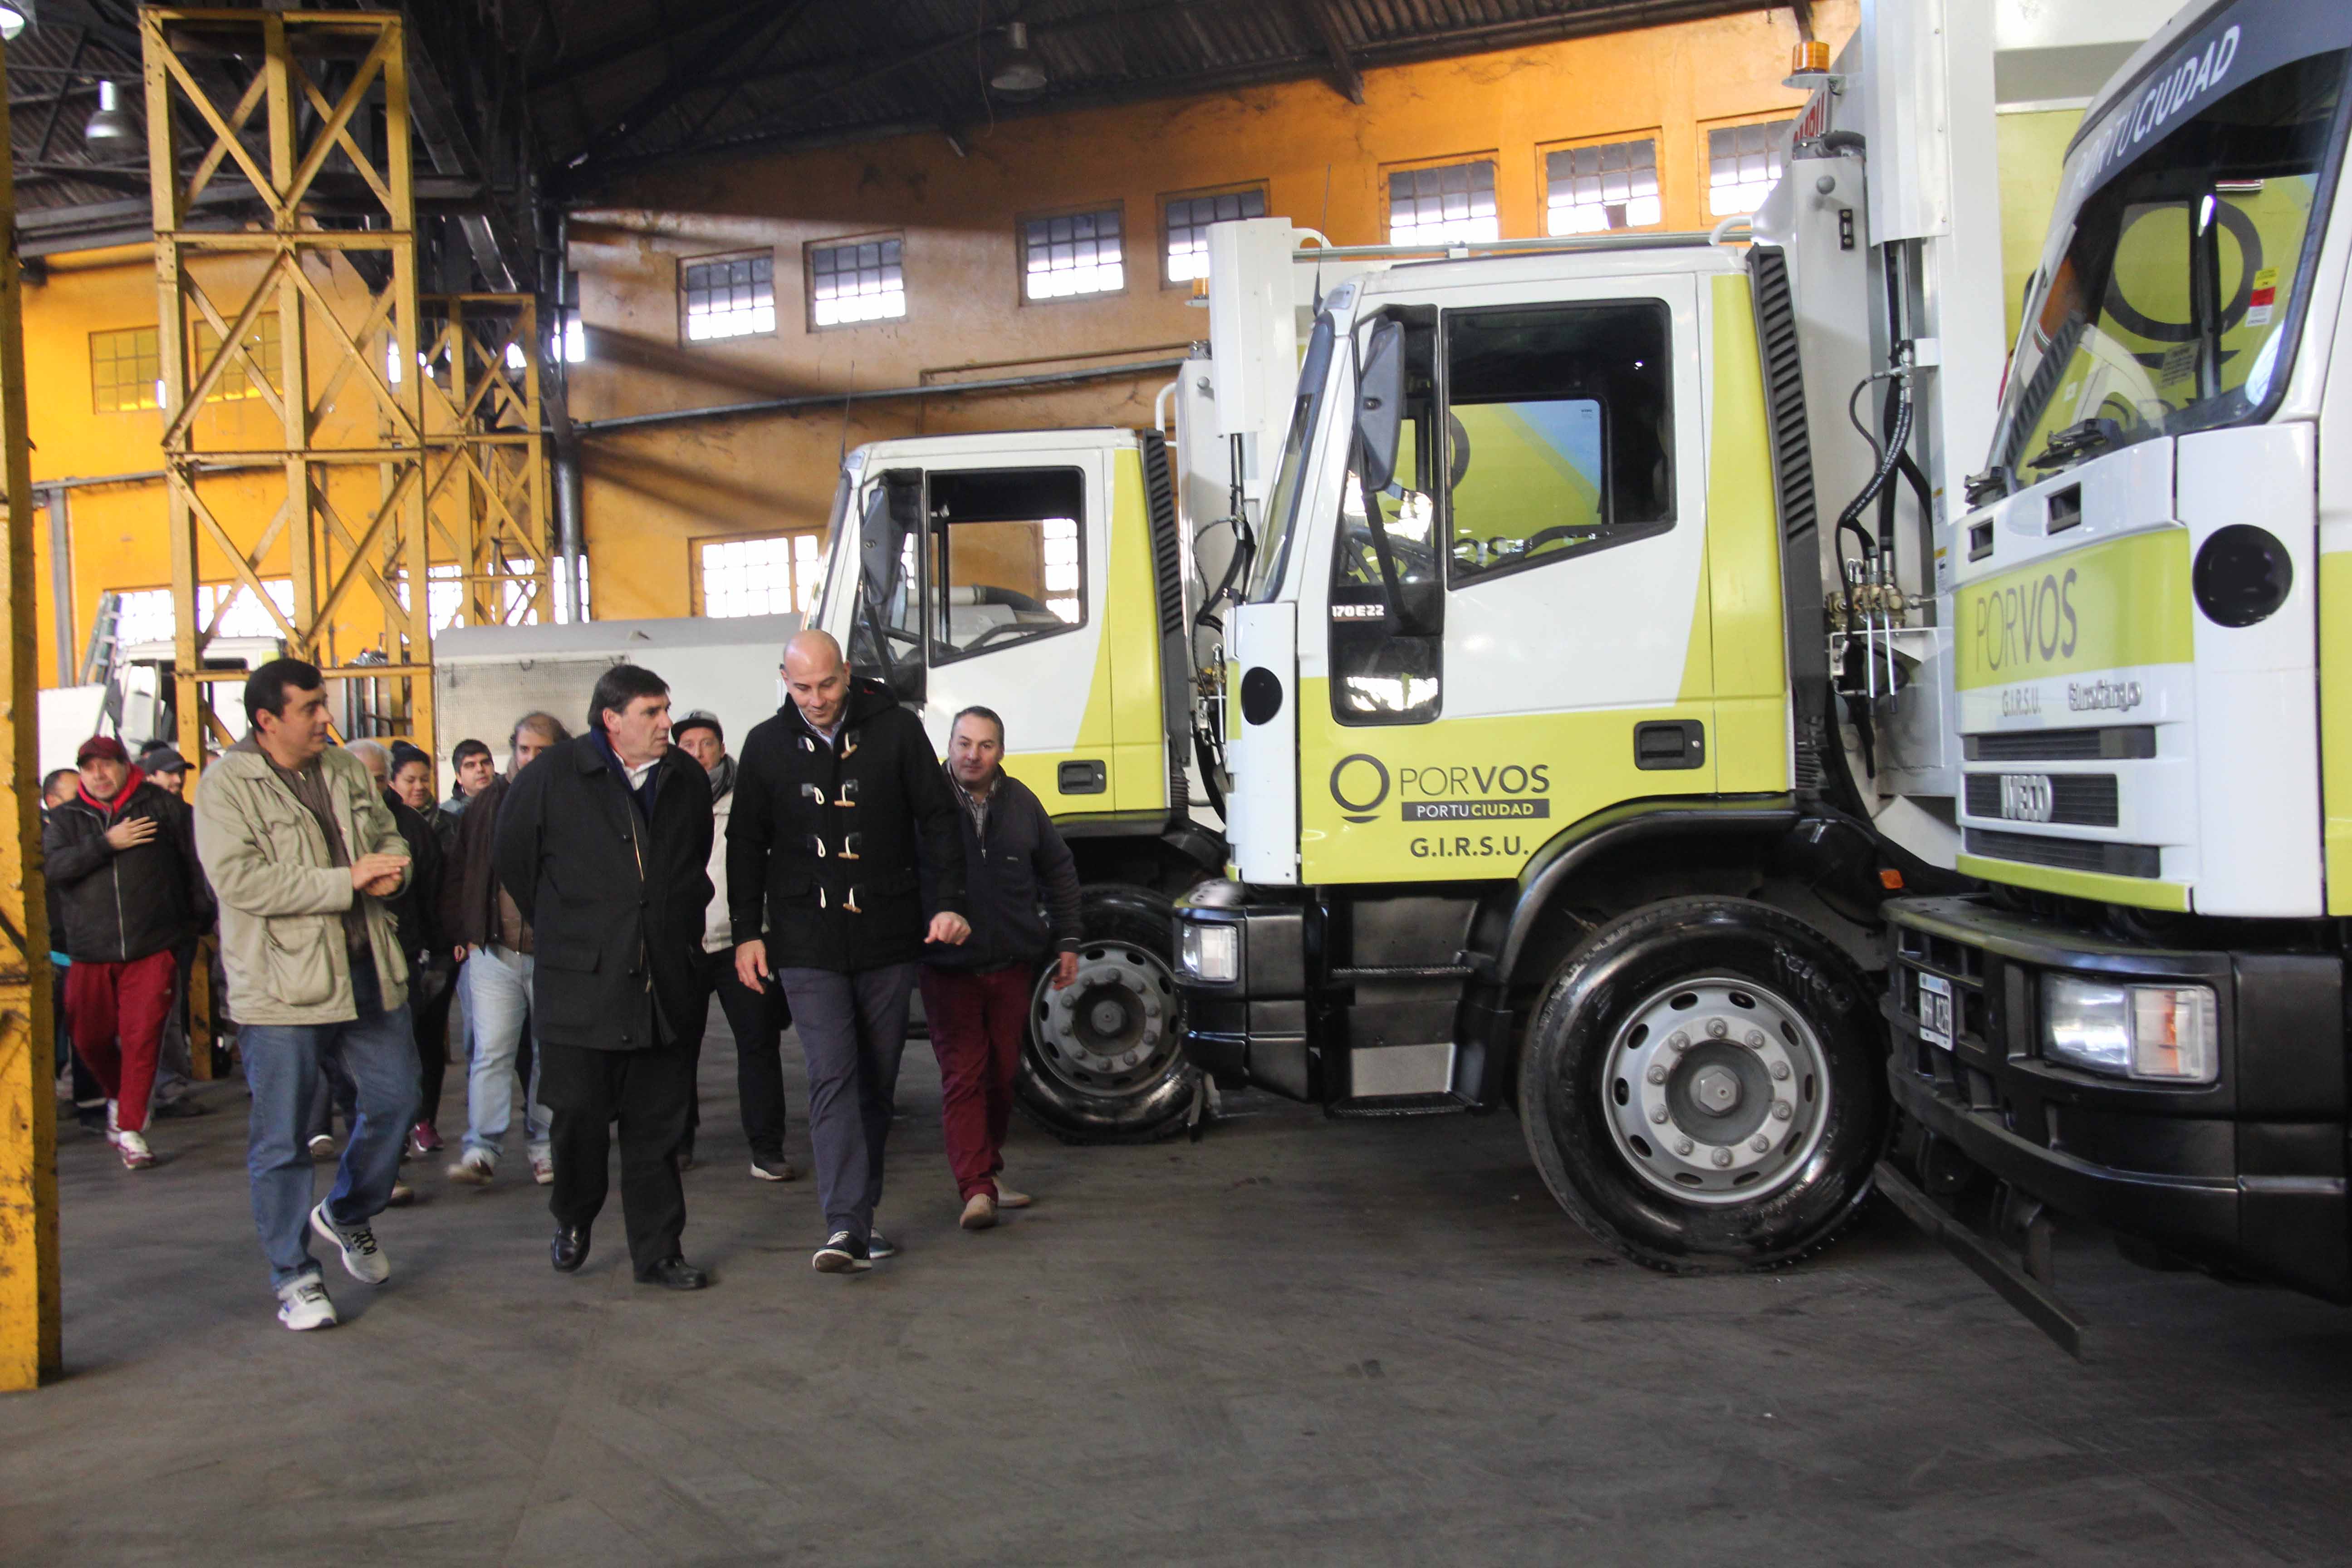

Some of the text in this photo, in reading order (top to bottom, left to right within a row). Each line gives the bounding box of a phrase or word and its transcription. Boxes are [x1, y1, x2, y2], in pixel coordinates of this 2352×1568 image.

[1332, 604, 1384, 617] 170E22
[2000, 775, 2052, 822] IVECO
[1410, 836, 1529, 857] G.I.R.S.U.
